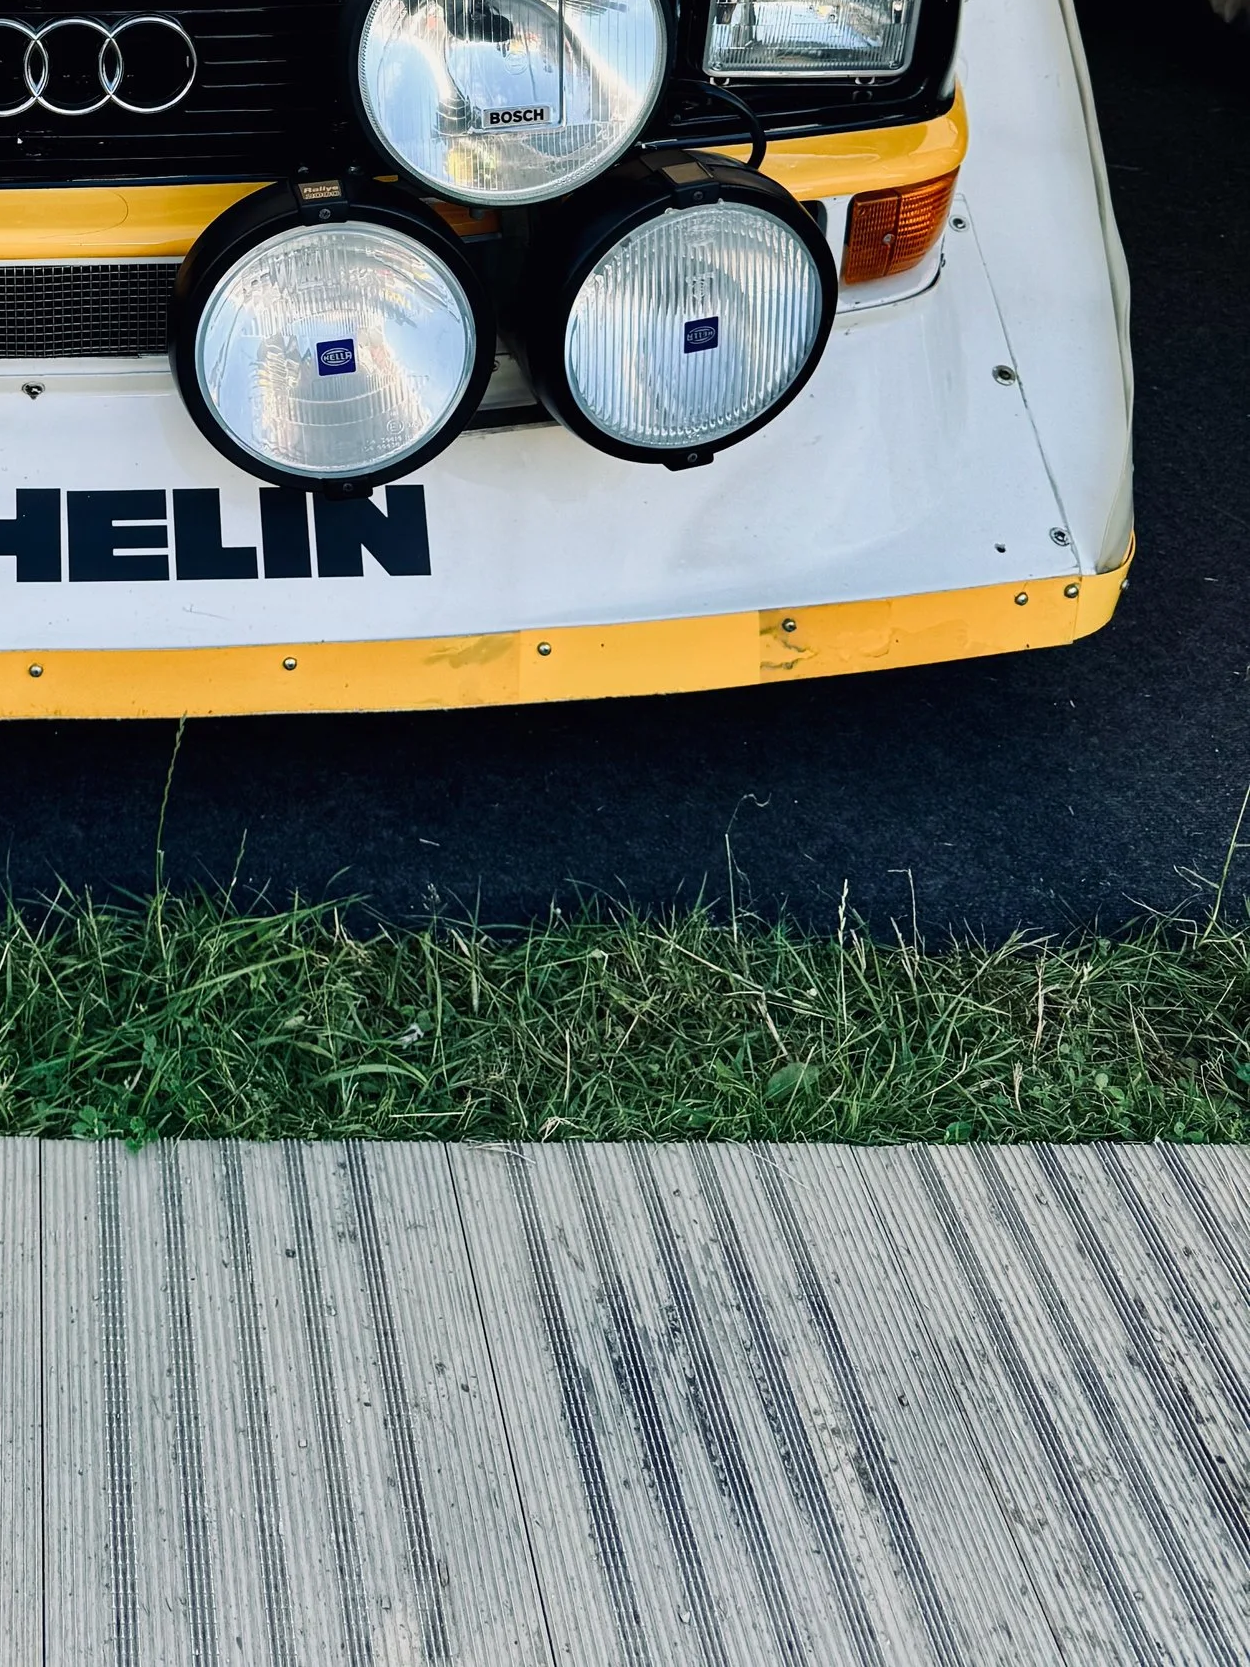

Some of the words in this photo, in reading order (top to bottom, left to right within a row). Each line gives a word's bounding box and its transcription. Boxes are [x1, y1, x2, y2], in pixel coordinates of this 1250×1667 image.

[489, 108, 545, 125] BOSCH
[303, 185, 339, 194] Rallye
[322, 349, 353, 363] HELLA
